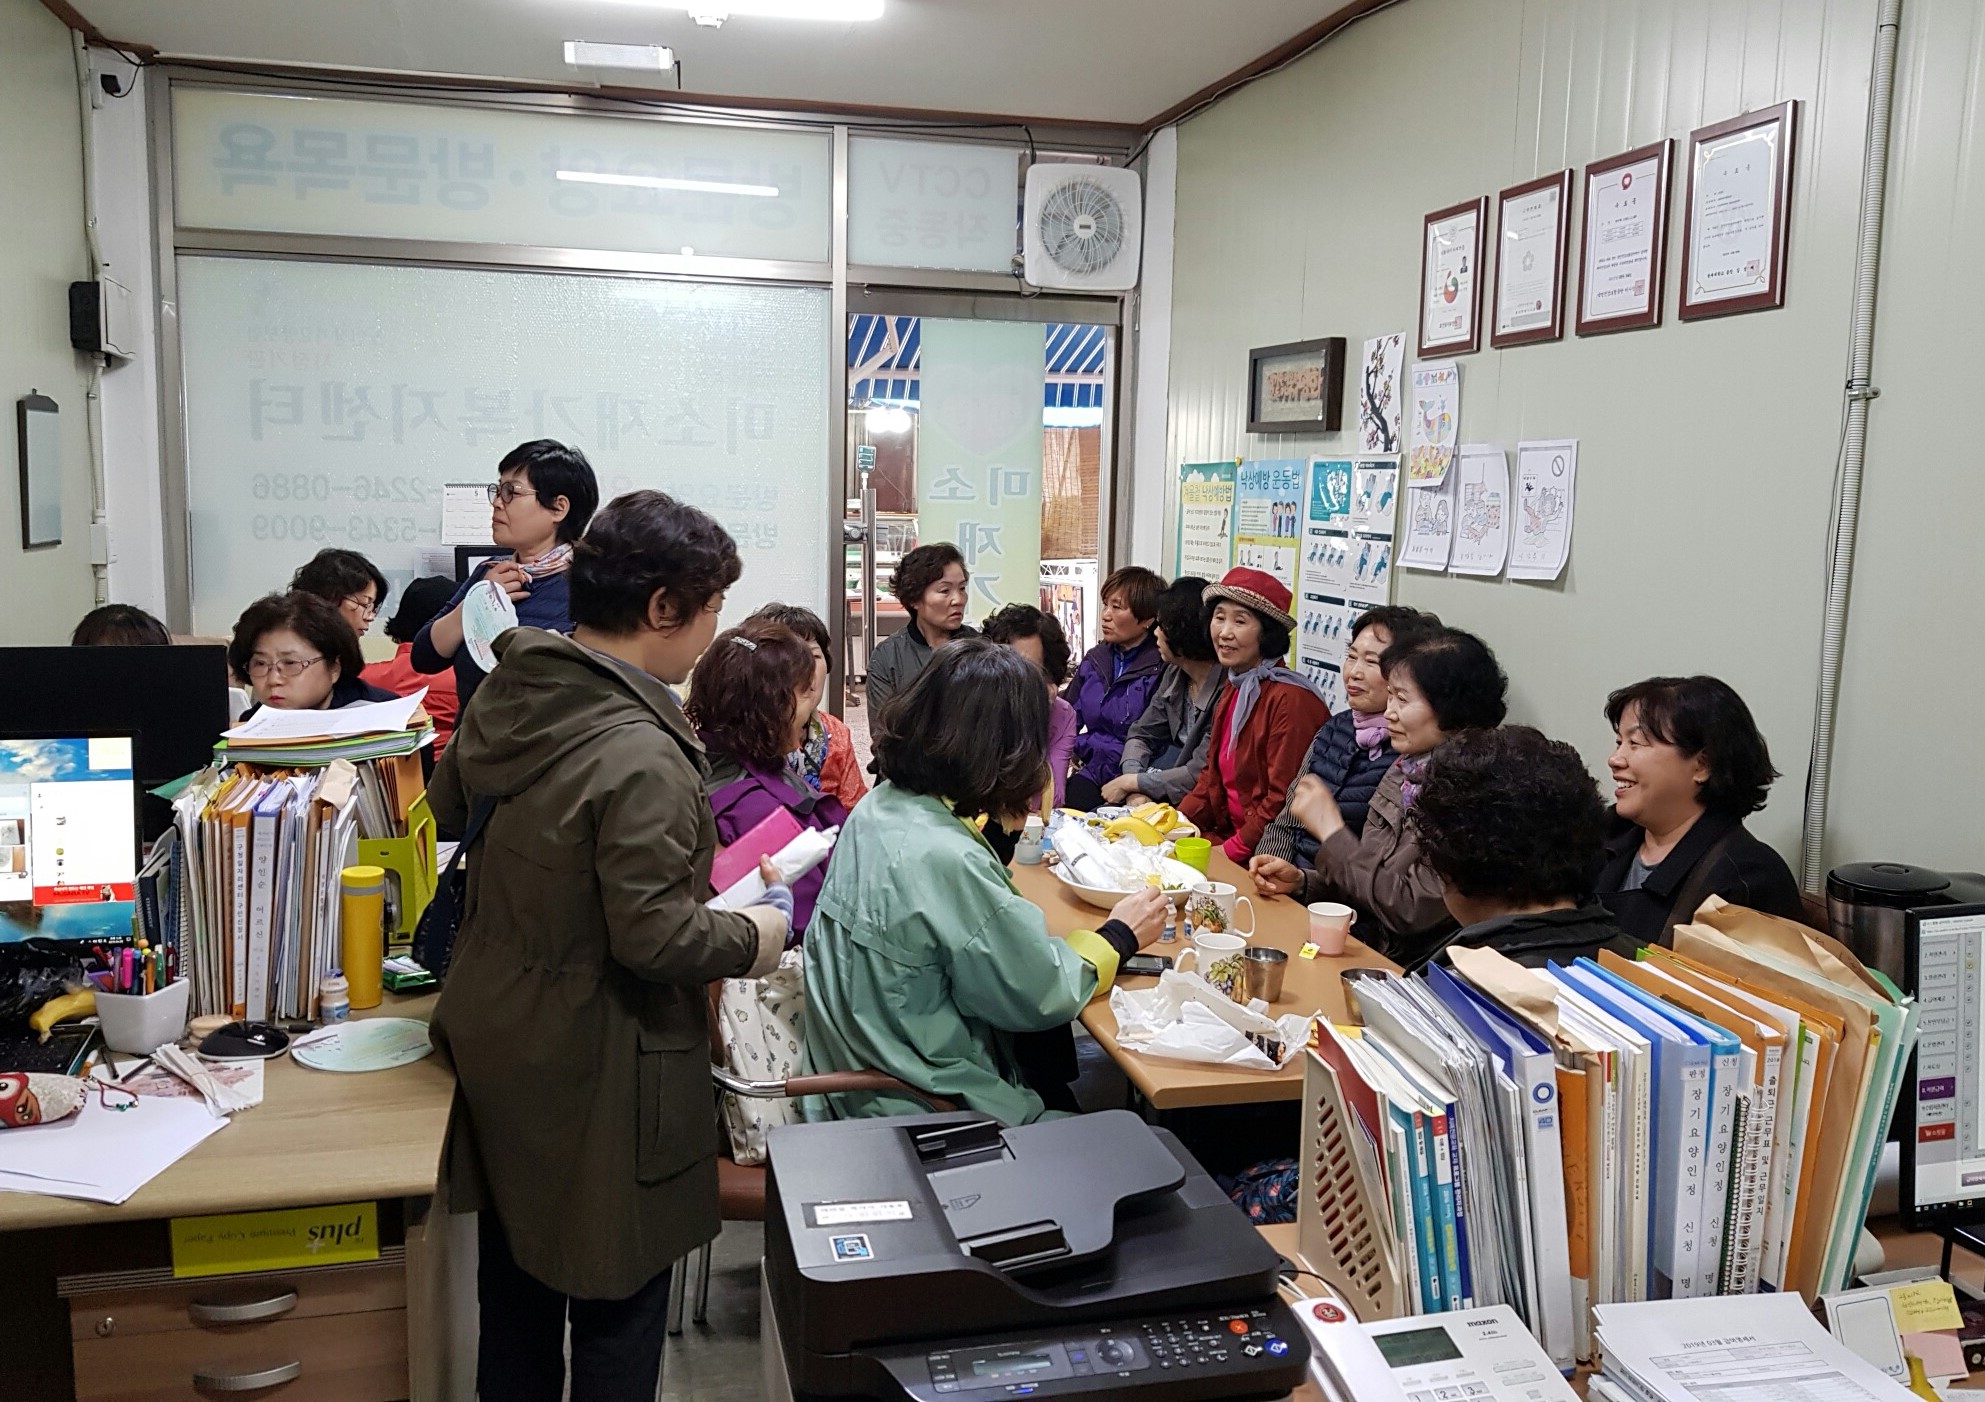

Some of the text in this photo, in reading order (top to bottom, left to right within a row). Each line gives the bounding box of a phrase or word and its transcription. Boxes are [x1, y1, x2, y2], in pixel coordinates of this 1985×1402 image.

[1240, 469, 1300, 491] 낙상예방 운동법
[1685, 1087, 1702, 1196] 장기요양인정
[1713, 1084, 1733, 1192] 장기요양인정
[1756, 1075, 1777, 1216] 출퇴근 근무표 및 근무일지
[184, 1215, 362, 1245] plus Premium Copy Paper
[1682, 1221, 1695, 1252] 신청
[1708, 1216, 1720, 1248] 신청
[1466, 1318, 1499, 1327] maxon
[1682, 1340, 1706, 1349] 2019년
[1723, 1335, 1757, 1345] 급여명세서
[1439, 1390, 1449, 1399] 2
[1468, 1387, 1477, 1396] 3
